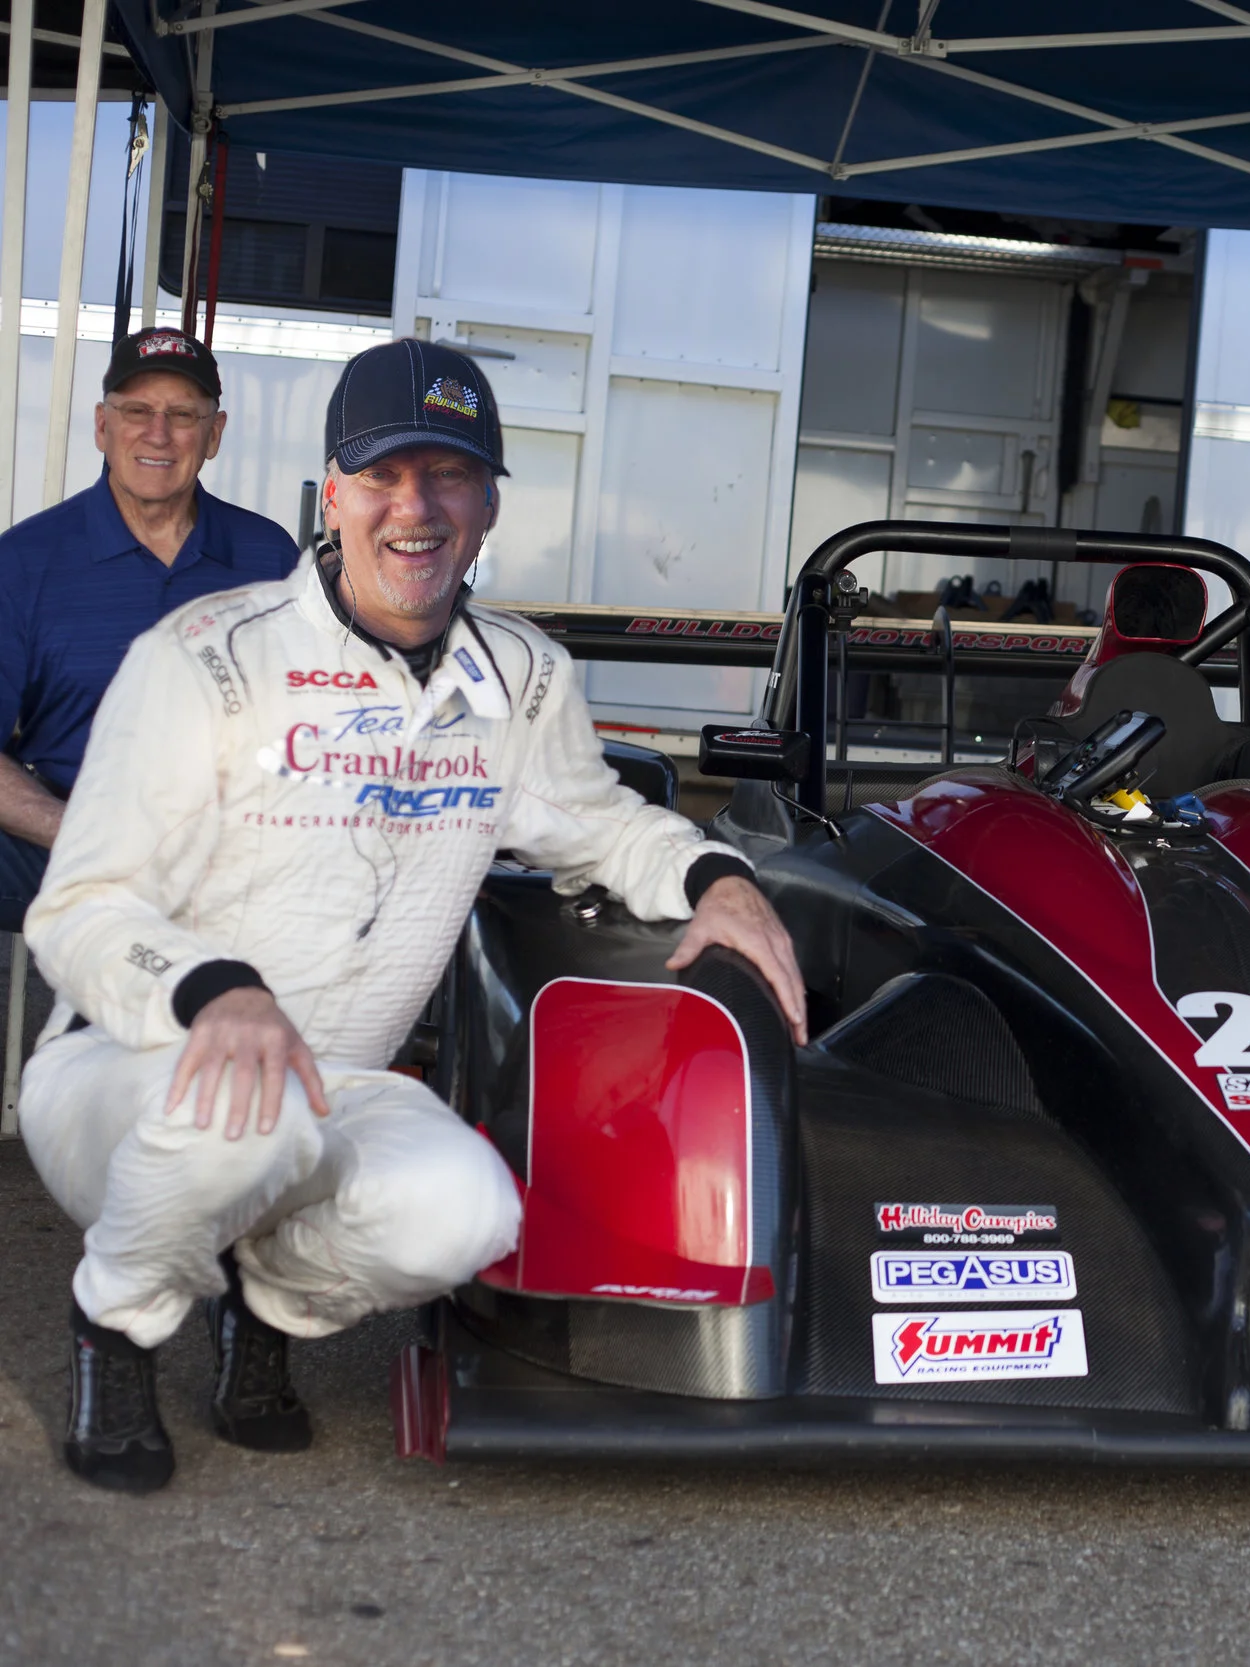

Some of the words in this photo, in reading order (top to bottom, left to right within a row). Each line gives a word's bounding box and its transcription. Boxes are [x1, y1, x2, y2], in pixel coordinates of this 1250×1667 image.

[424, 394, 478, 418] BULLDOG
[625, 618, 784, 640] BULLDO
[286, 669, 379, 689] SCCA
[878, 1204, 962, 1233] Holliday
[963, 1206, 1057, 1235] Canopies
[887, 1256, 1060, 1289] PEGASUS
[917, 1366, 968, 1374] RACING
[972, 1363, 1052, 1373] EQUIPMENT
